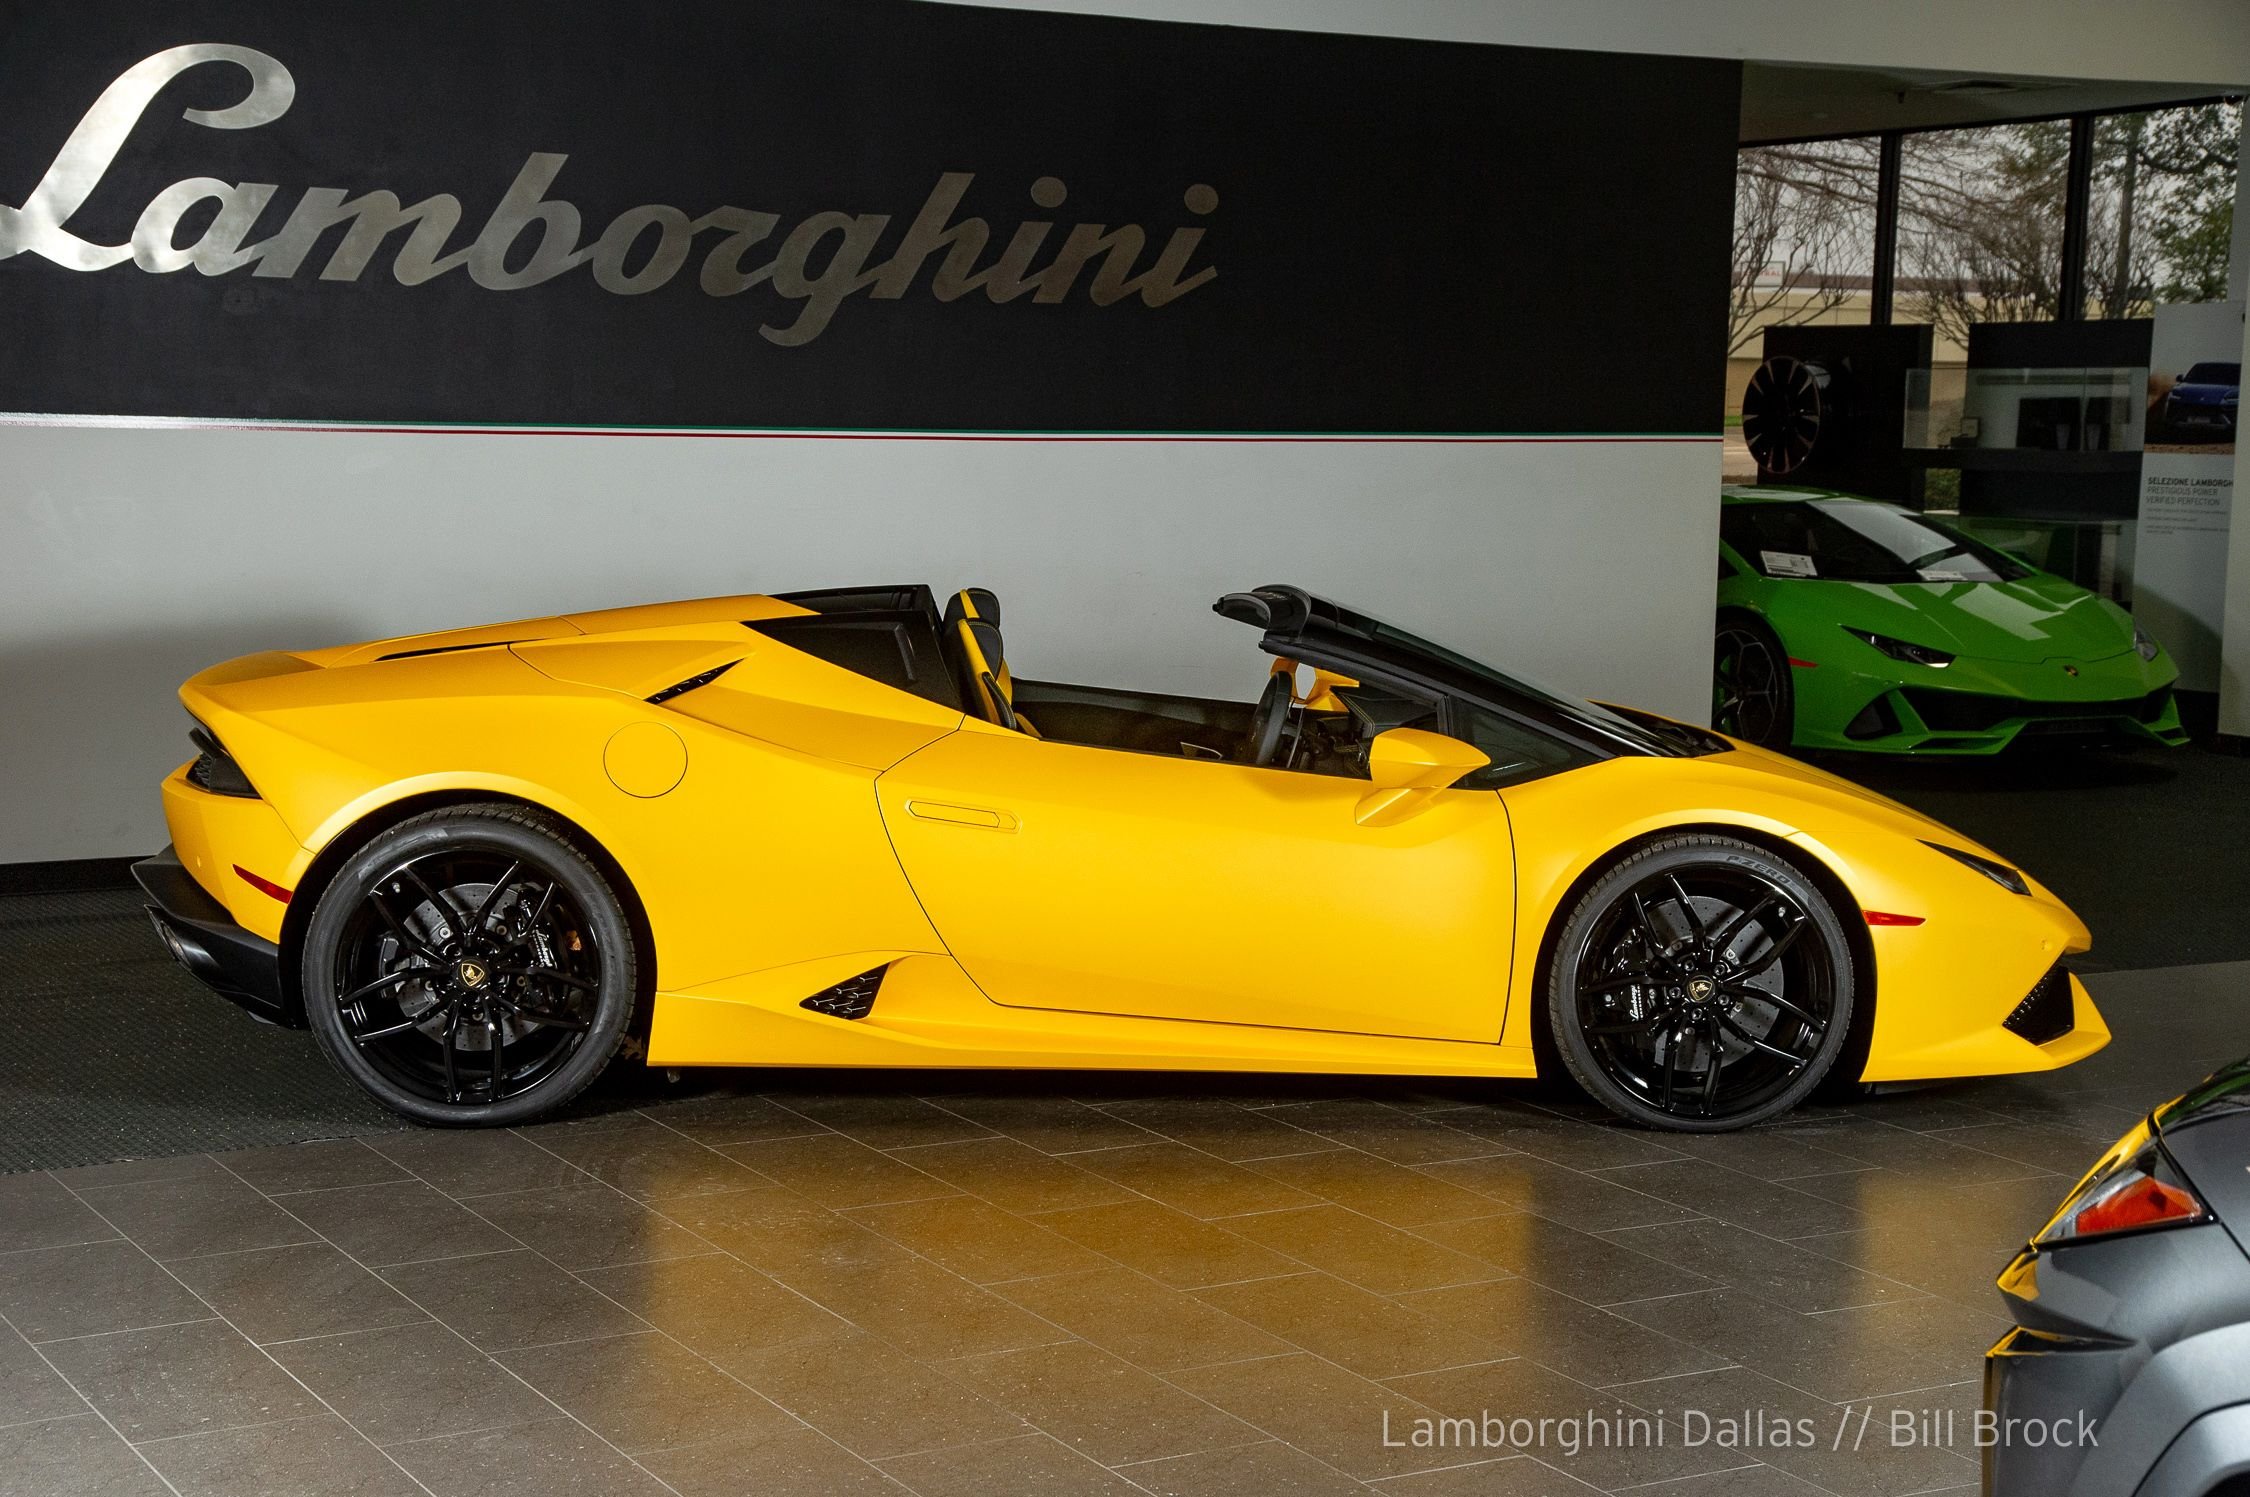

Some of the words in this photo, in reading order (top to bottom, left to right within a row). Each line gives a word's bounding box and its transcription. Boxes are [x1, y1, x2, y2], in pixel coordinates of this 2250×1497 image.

[0, 43, 1218, 347] Lamborghini
[2148, 477, 2189, 486] SELEZIONE
[2193, 487, 2218, 497] POWER
[2177, 497, 2220, 506] PERFECTION
